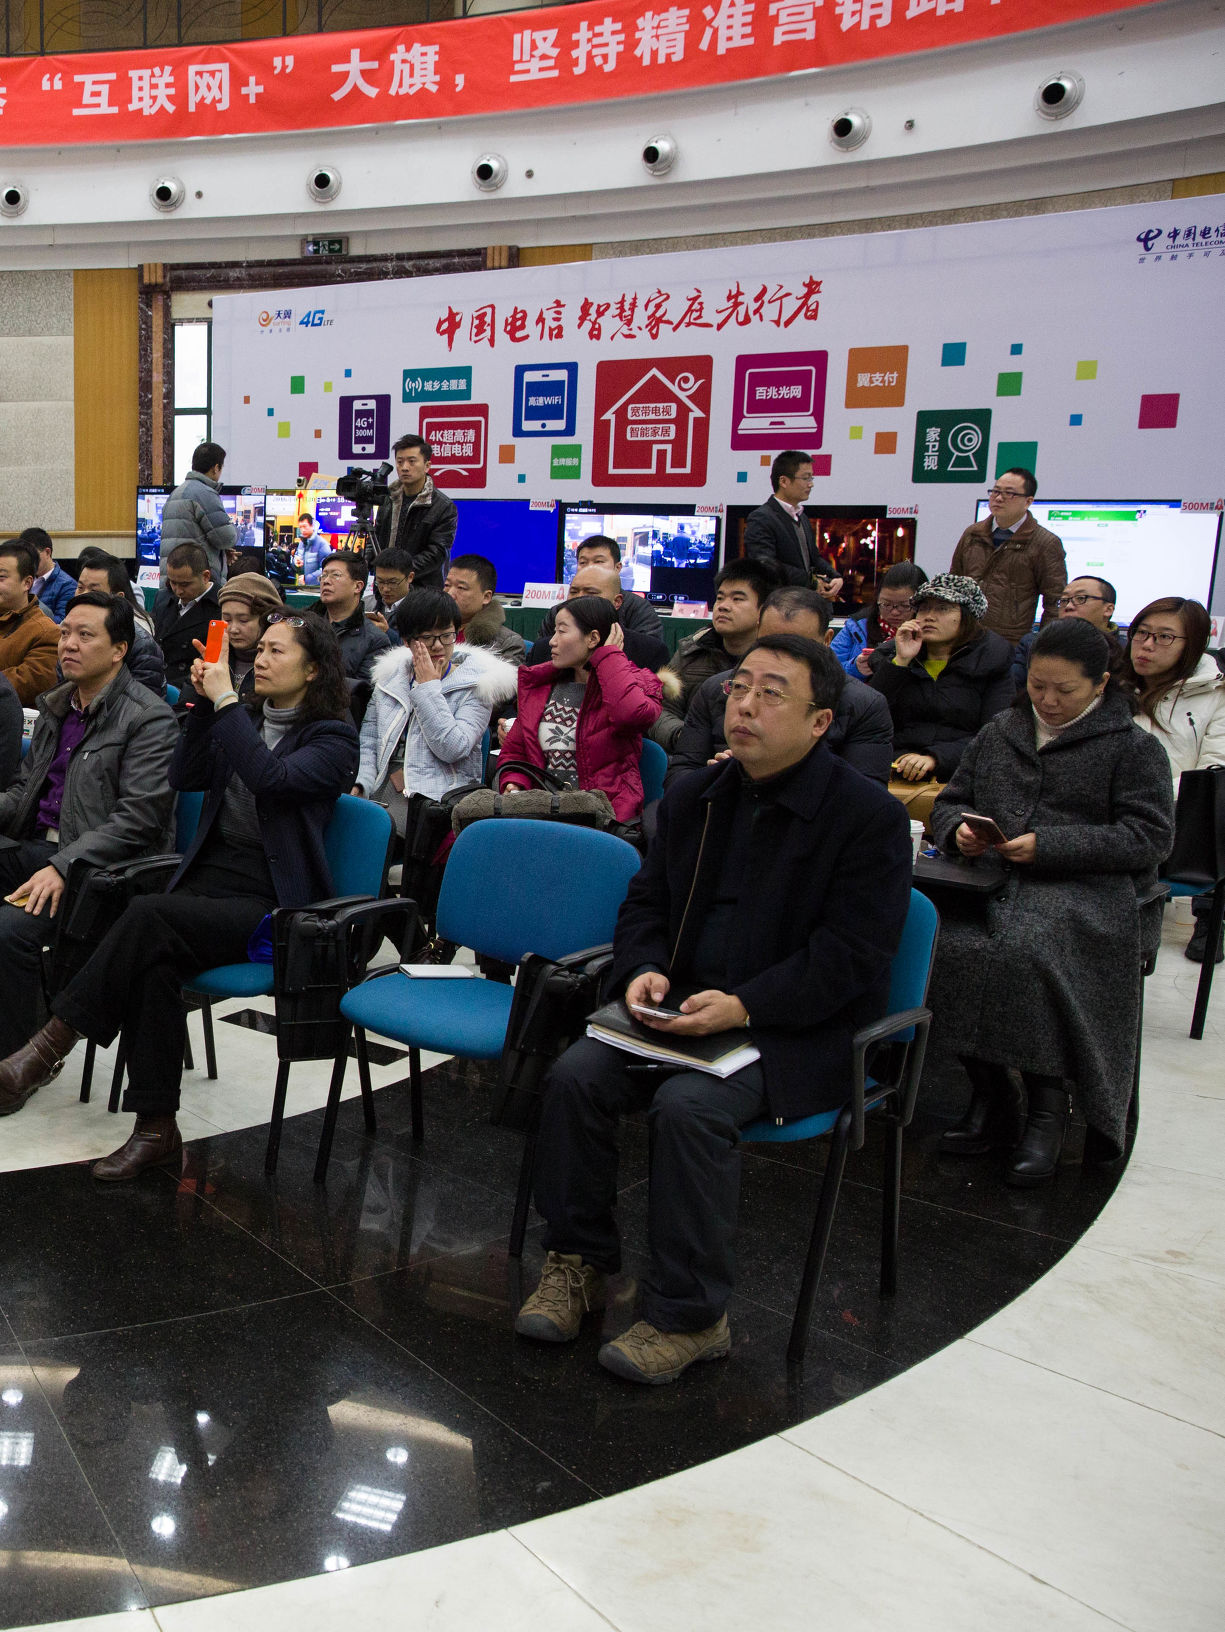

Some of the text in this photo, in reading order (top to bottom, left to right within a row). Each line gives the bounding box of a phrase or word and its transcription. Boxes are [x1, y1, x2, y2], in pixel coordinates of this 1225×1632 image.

[424, 379, 467, 391] 城乡全覆盖
[857, 371, 899, 387] 翼支付
[755, 385, 803, 400] 百兆光网
[630, 404, 673, 418] 宽带电视
[355, 416, 374, 428] 4G+
[355, 429, 374, 437] 300M
[429, 428, 476, 443] 4K超高清
[629, 425, 672, 439] 智能家居
[431, 443, 474, 457] 电信电视
[923, 427, 941, 471] 家卫视
[888, 506, 909, 515] 500M
[1182, 502, 1209, 511] 500M
[525, 589, 551, 600] 200M
